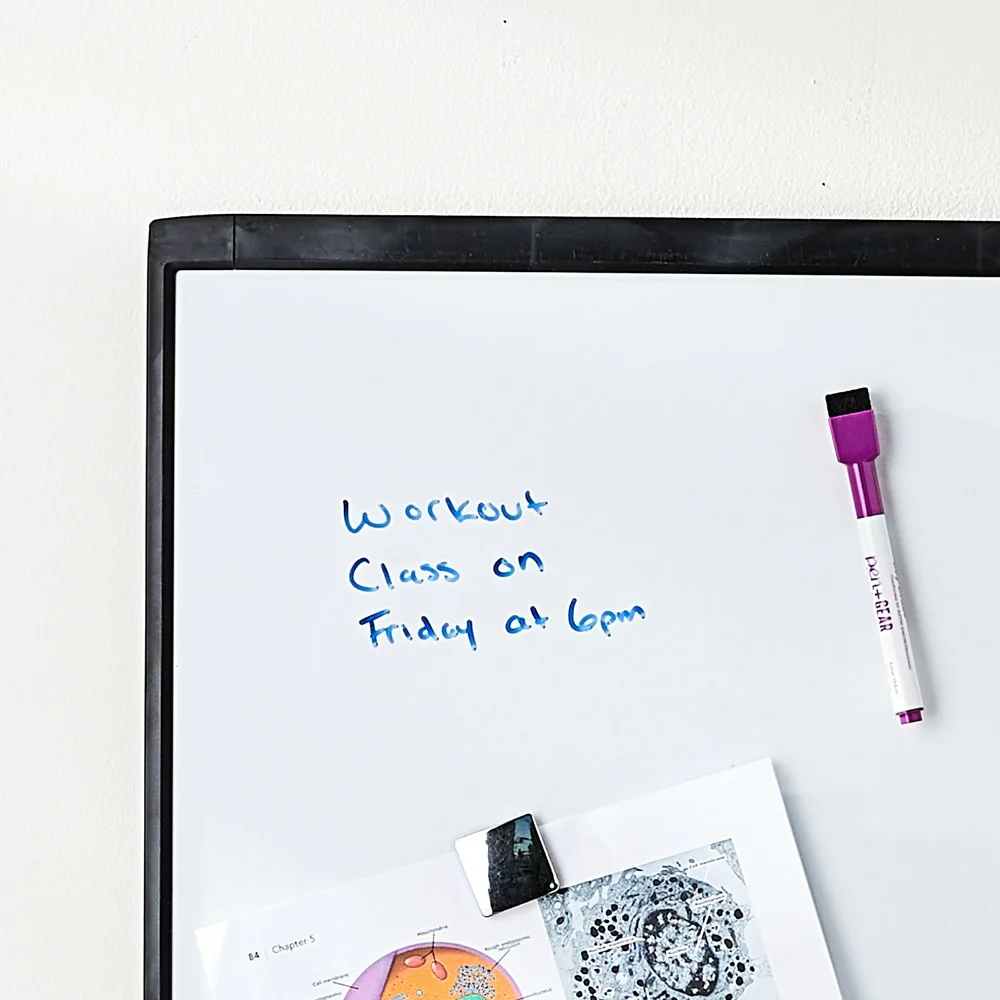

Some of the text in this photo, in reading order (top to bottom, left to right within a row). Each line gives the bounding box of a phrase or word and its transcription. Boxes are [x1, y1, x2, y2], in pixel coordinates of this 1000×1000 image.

[343, 490, 548, 534] Workout
[350, 551, 544, 592] Class on
[865, 556, 893, 632] pen+GEAR
[359, 598, 646, 650] Friday at 6pm
[248, 935, 316, 961] 84 Chapter 5
